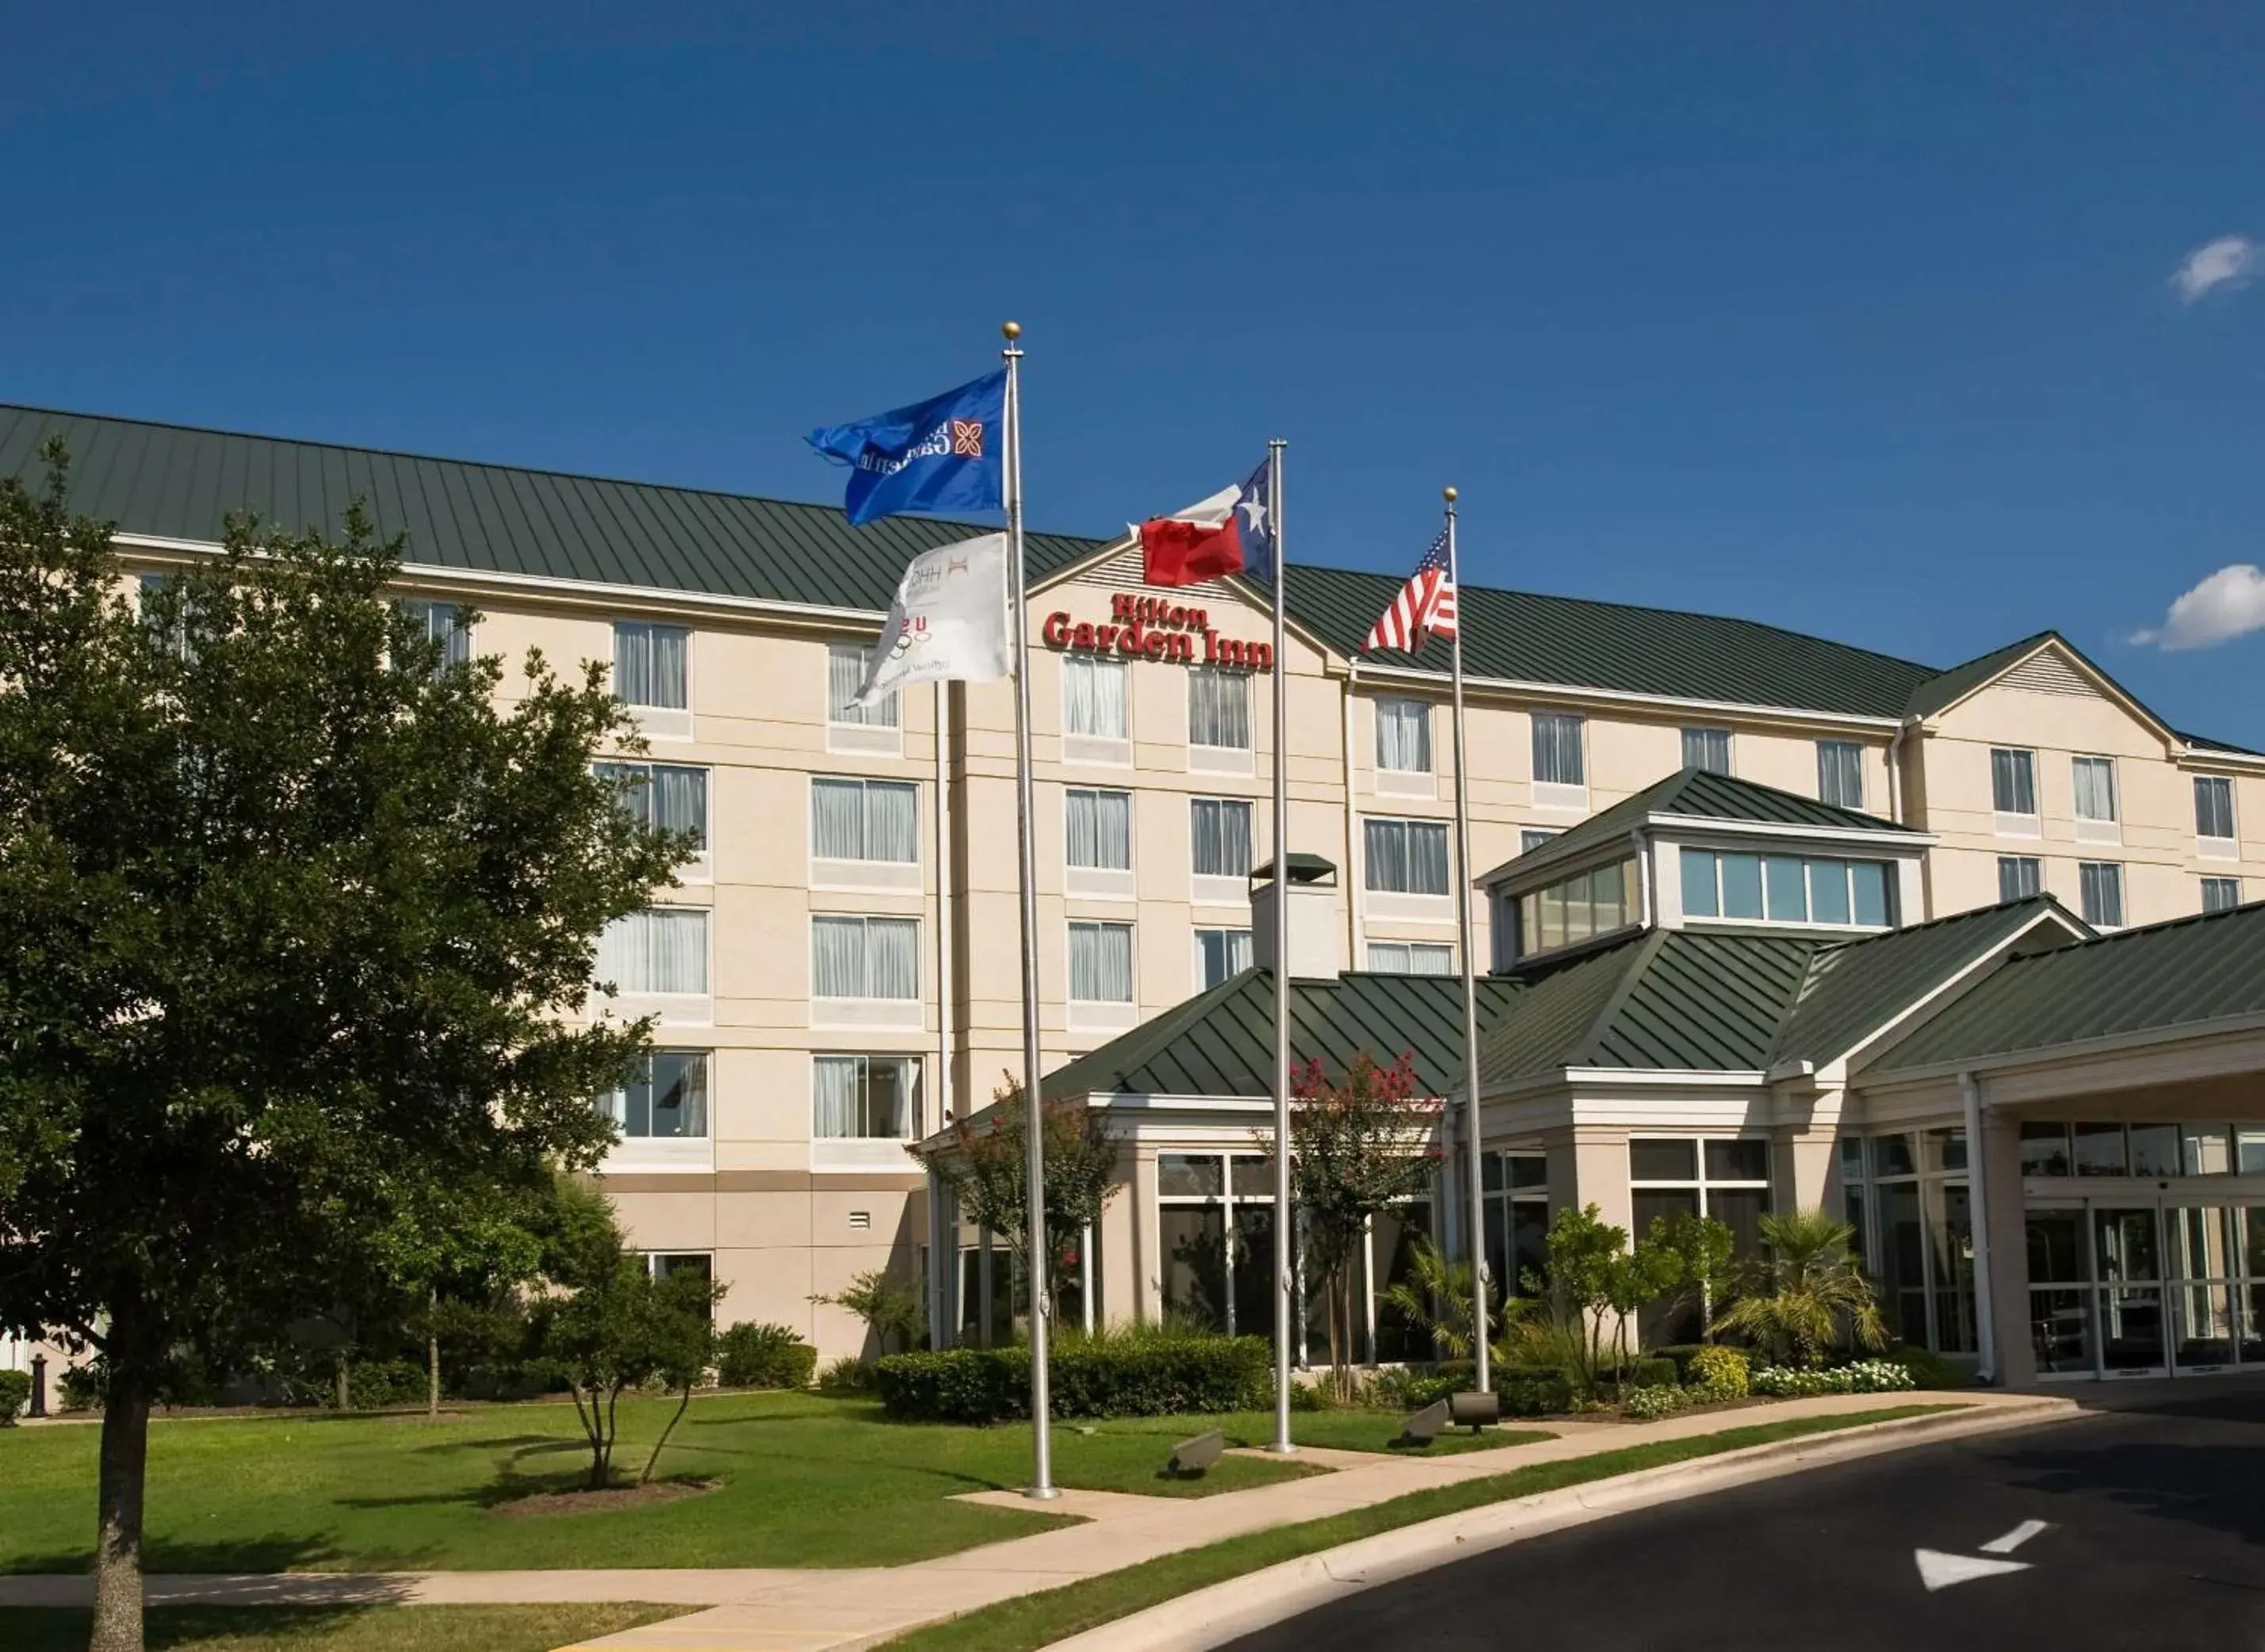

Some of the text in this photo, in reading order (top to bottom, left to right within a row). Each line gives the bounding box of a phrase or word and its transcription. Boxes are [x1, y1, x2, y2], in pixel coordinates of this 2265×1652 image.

[1111, 592, 1209, 629] Hilton
[1043, 611, 1274, 671] Garden Inn
